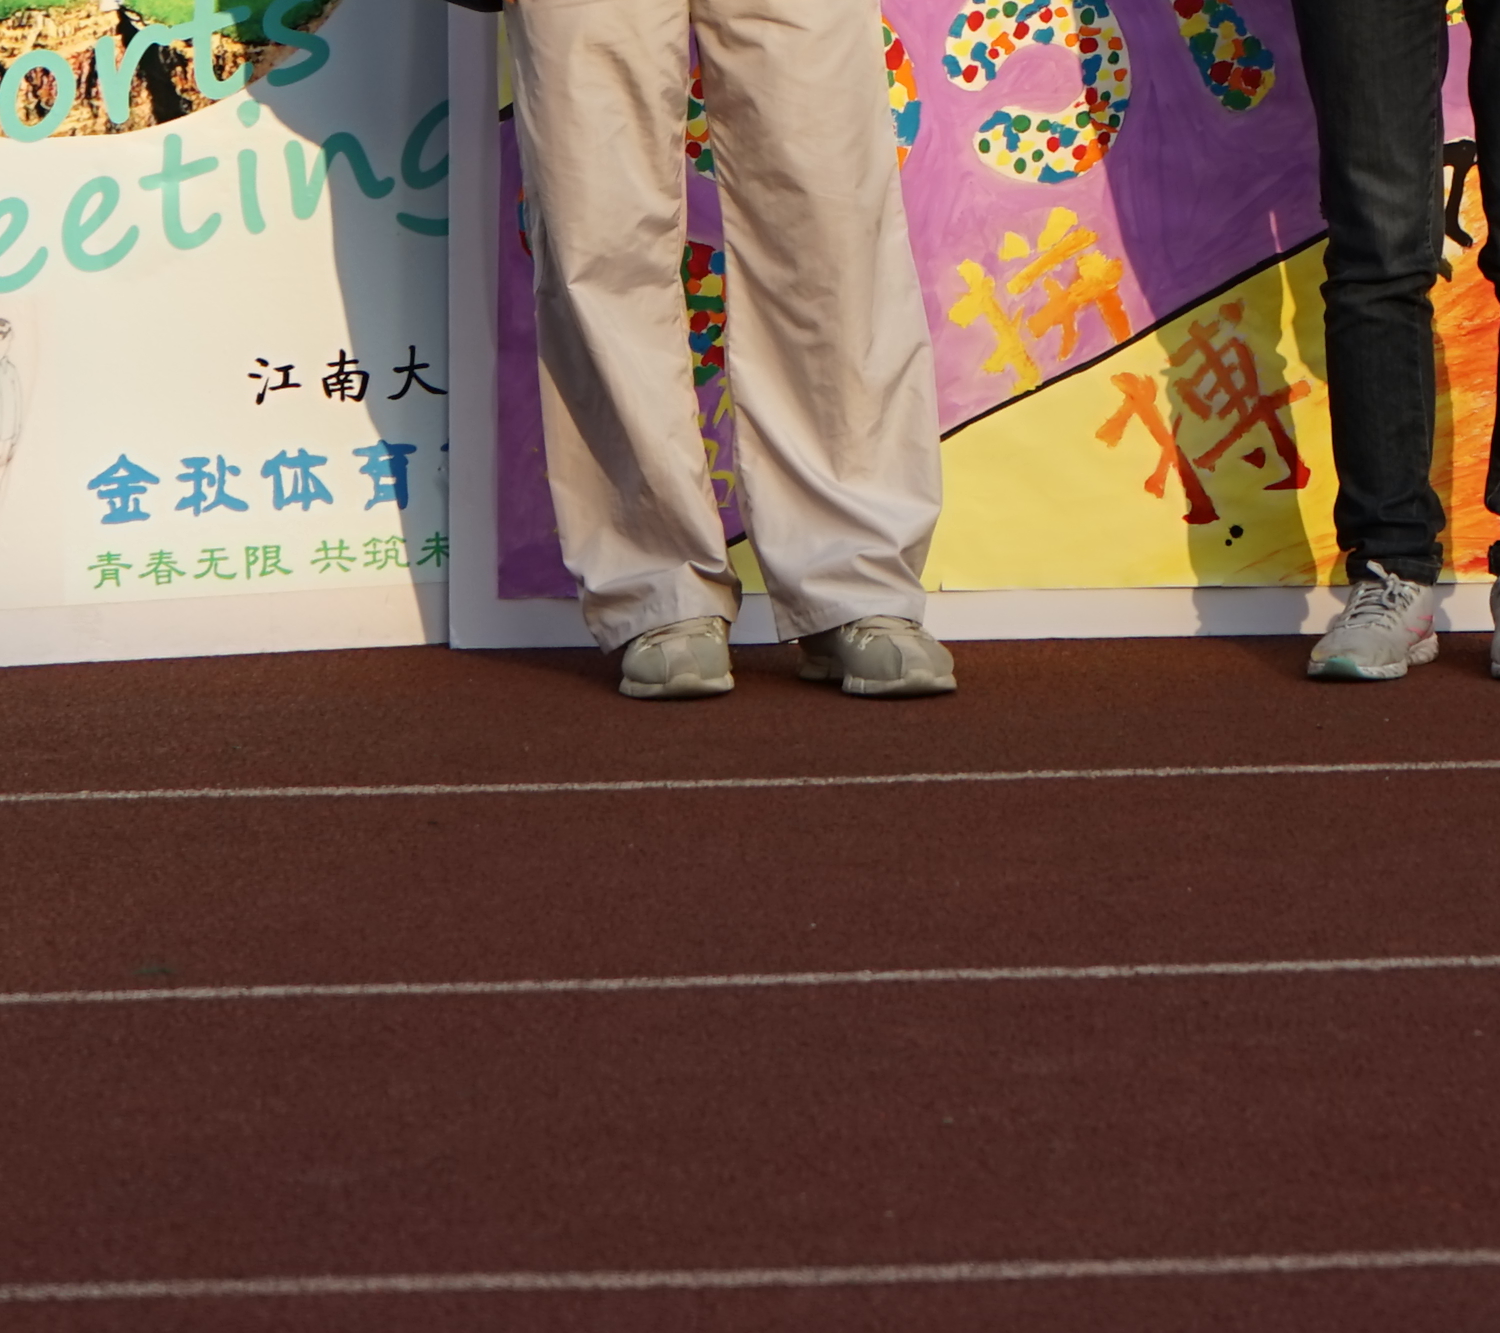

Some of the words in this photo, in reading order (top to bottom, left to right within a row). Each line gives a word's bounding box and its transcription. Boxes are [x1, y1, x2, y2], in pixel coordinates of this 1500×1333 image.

[247, 345, 449, 405] 江南大
[87, 439, 449, 525] 金秋体育
[87, 544, 294, 590] 青春无限
